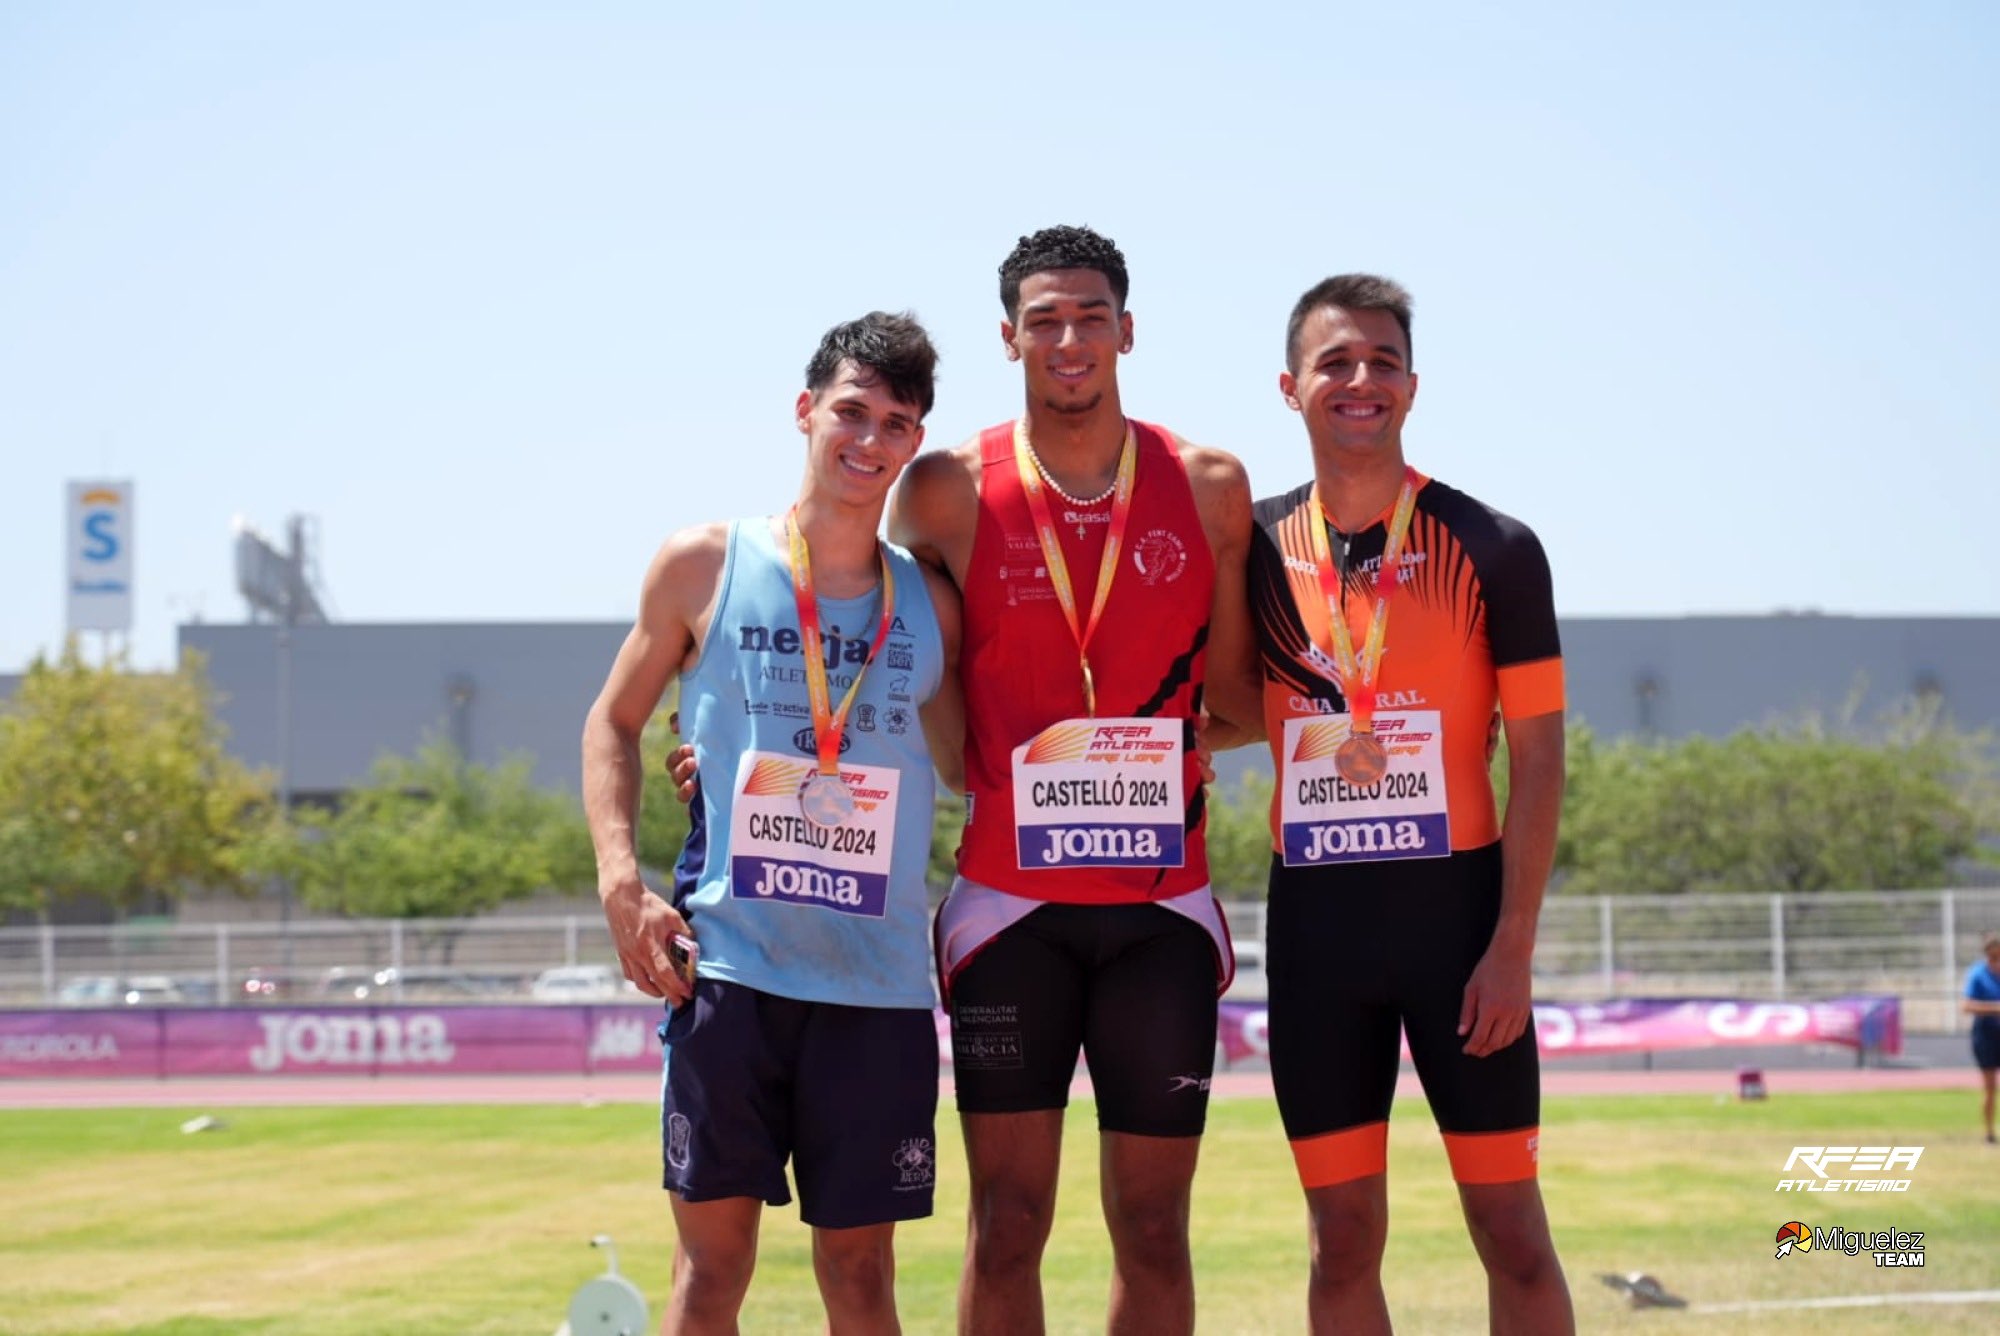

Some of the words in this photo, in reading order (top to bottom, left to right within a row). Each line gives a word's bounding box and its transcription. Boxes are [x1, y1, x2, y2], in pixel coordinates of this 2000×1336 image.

[1089, 741, 1174, 750] ATLETISMO
[1094, 726, 1153, 740] RFEA
[1033, 772, 1125, 807] CASTELLÓ
[1129, 780, 1168, 806] 2024
[1385, 772, 1428, 799] 2024
[832, 826, 876, 855] 2024
